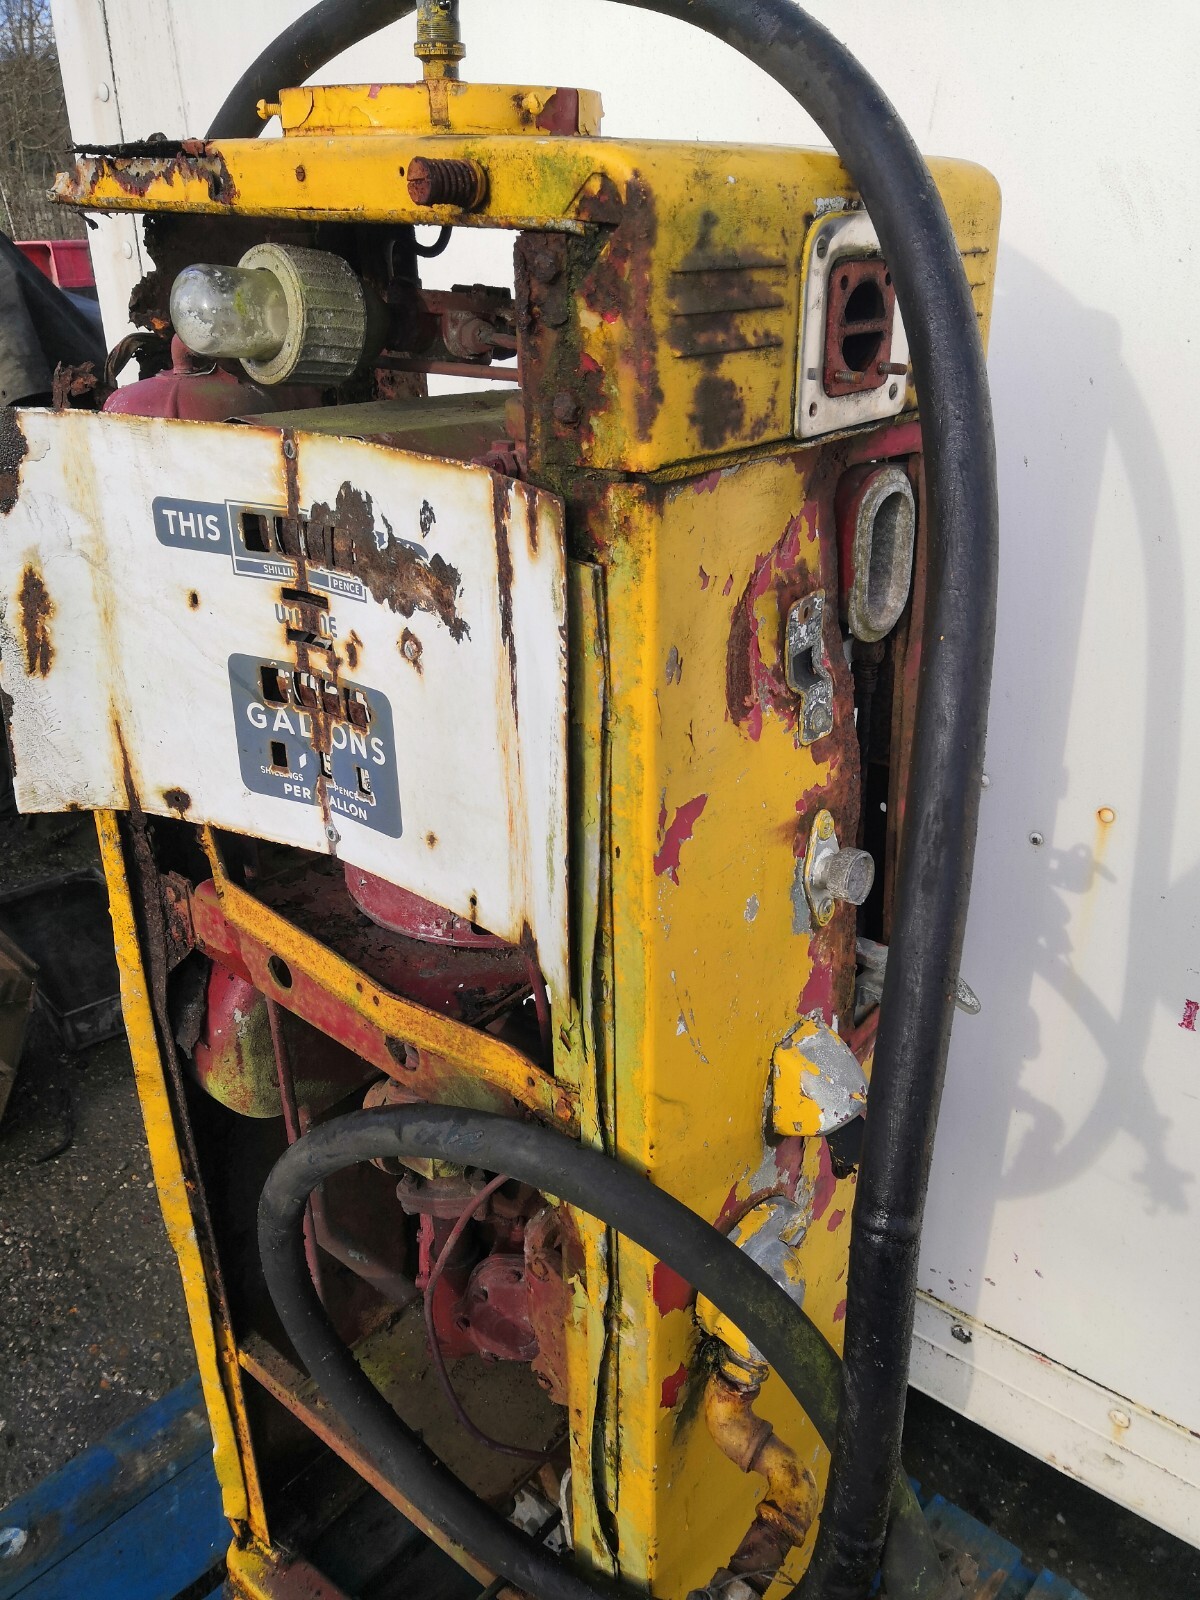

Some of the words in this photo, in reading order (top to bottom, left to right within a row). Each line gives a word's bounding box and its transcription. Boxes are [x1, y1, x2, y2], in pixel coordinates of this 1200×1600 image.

[162, 509, 221, 541] THIS
[263, 564, 299, 577] SHILLIN
[333, 579, 360, 595] PENCE
[246, 702, 386, 766] GALONS
[283, 783, 312, 800] PER
[329, 795, 368, 821] ALLON
